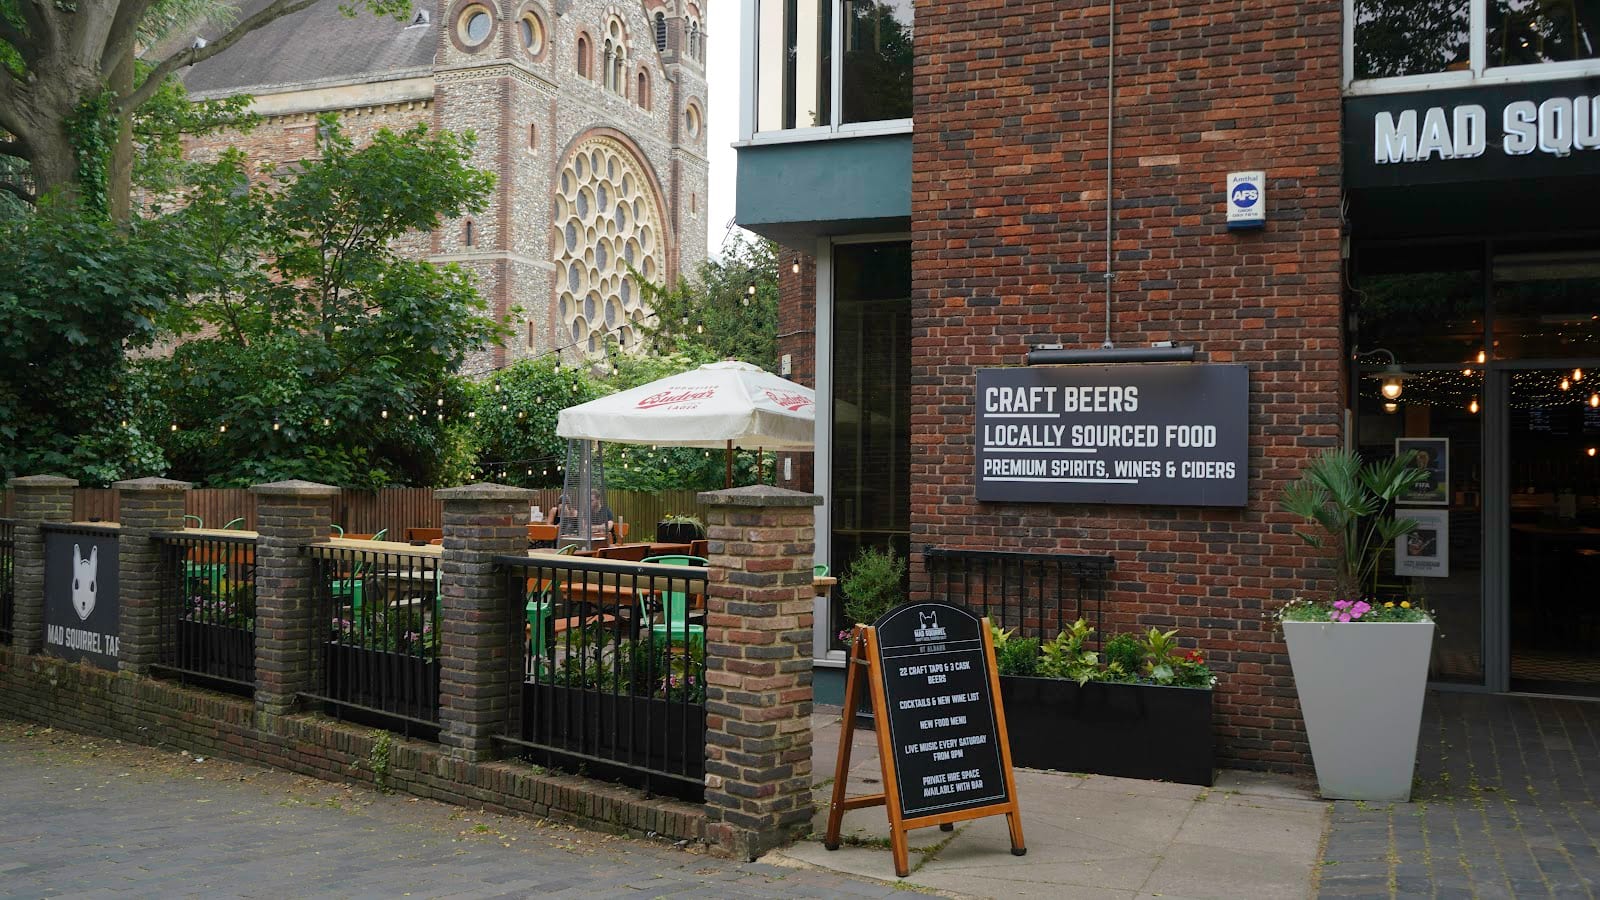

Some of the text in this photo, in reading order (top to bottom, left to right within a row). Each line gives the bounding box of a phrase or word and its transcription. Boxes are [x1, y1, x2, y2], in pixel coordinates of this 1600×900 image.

[1375, 104, 1486, 164] MAD
[1232, 190, 1258, 201] AFS
[985, 386, 1138, 412] CRAFT BEERS
[984, 424, 1217, 448] LOCALLY SOURCED FOOD
[983, 459, 1236, 479] PREMIUM SPIRITS, WINES & CIDERS
[47, 624, 64, 645] MAD
[65, 627, 103, 653] SQUIRREL
[899, 668, 908, 676] 22
[908, 666, 928, 676] CRAFT
[929, 664, 944, 674] TAPS
[950, 662, 954, 670] 3
[955, 662, 970, 670] CASK
[927, 674, 946, 684] BEERS
[899, 698, 930, 710] COCKTAILS
[937, 696, 950, 704] NEW
[952, 694, 966, 704] WINE
[967, 692, 980, 702] LIST
[920, 716, 966, 730] NEW FOOD MENU
[904, 734, 986, 754] LIVE MUSIC EVERY SATURDAY
[933, 752, 950, 762] FROM
[922, 768, 980, 786] PRIVATE HIRE SPACE
[923, 780, 984, 798] AVAILABLE WITH BAR
